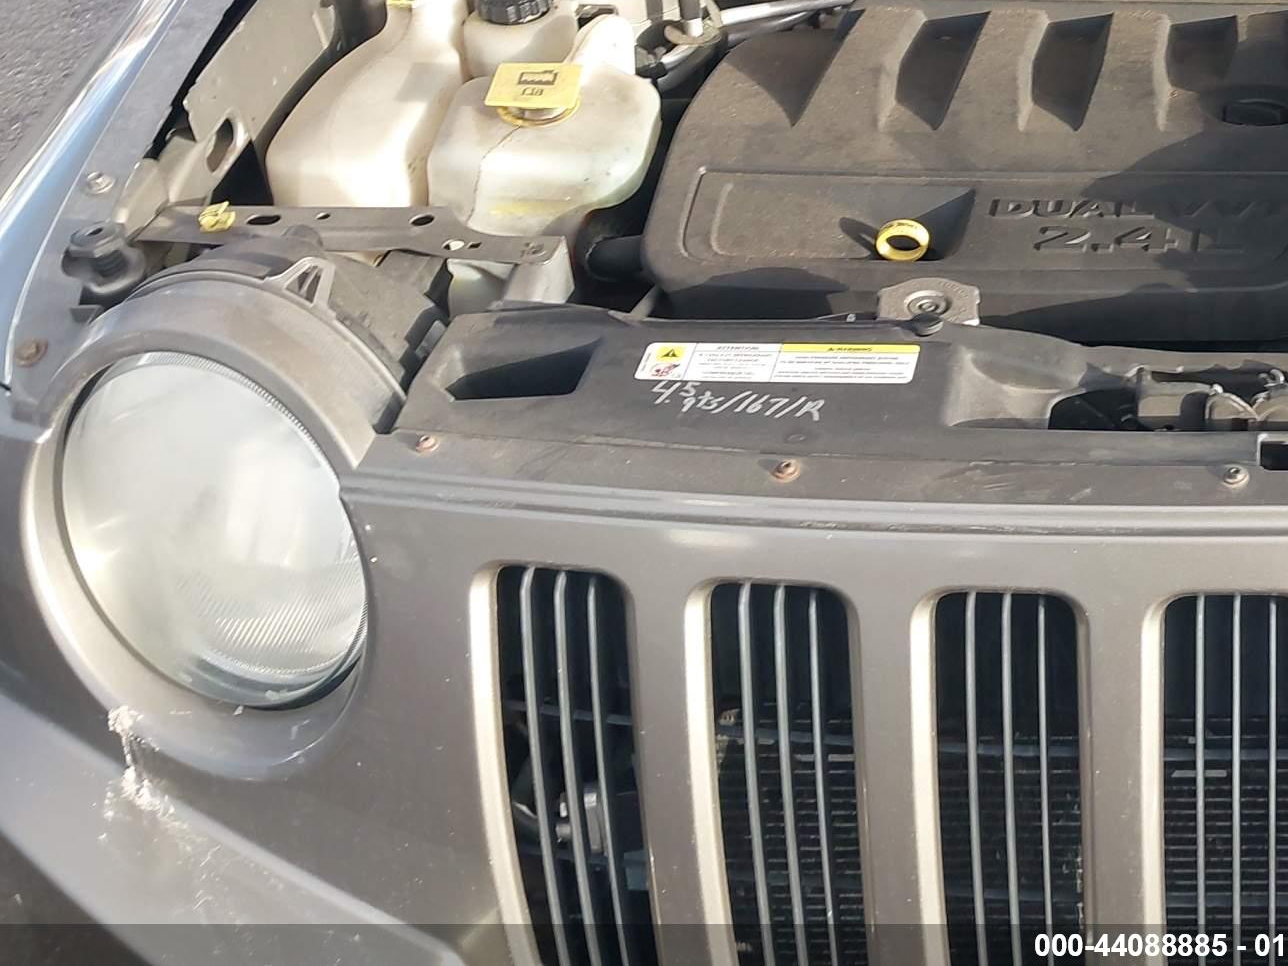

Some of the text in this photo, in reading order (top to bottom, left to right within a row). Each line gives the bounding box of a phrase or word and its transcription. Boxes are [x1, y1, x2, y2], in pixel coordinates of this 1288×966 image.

[988, 199, 1288, 220] DUAL VVT
[1034, 225, 1244, 253] 2.4L
